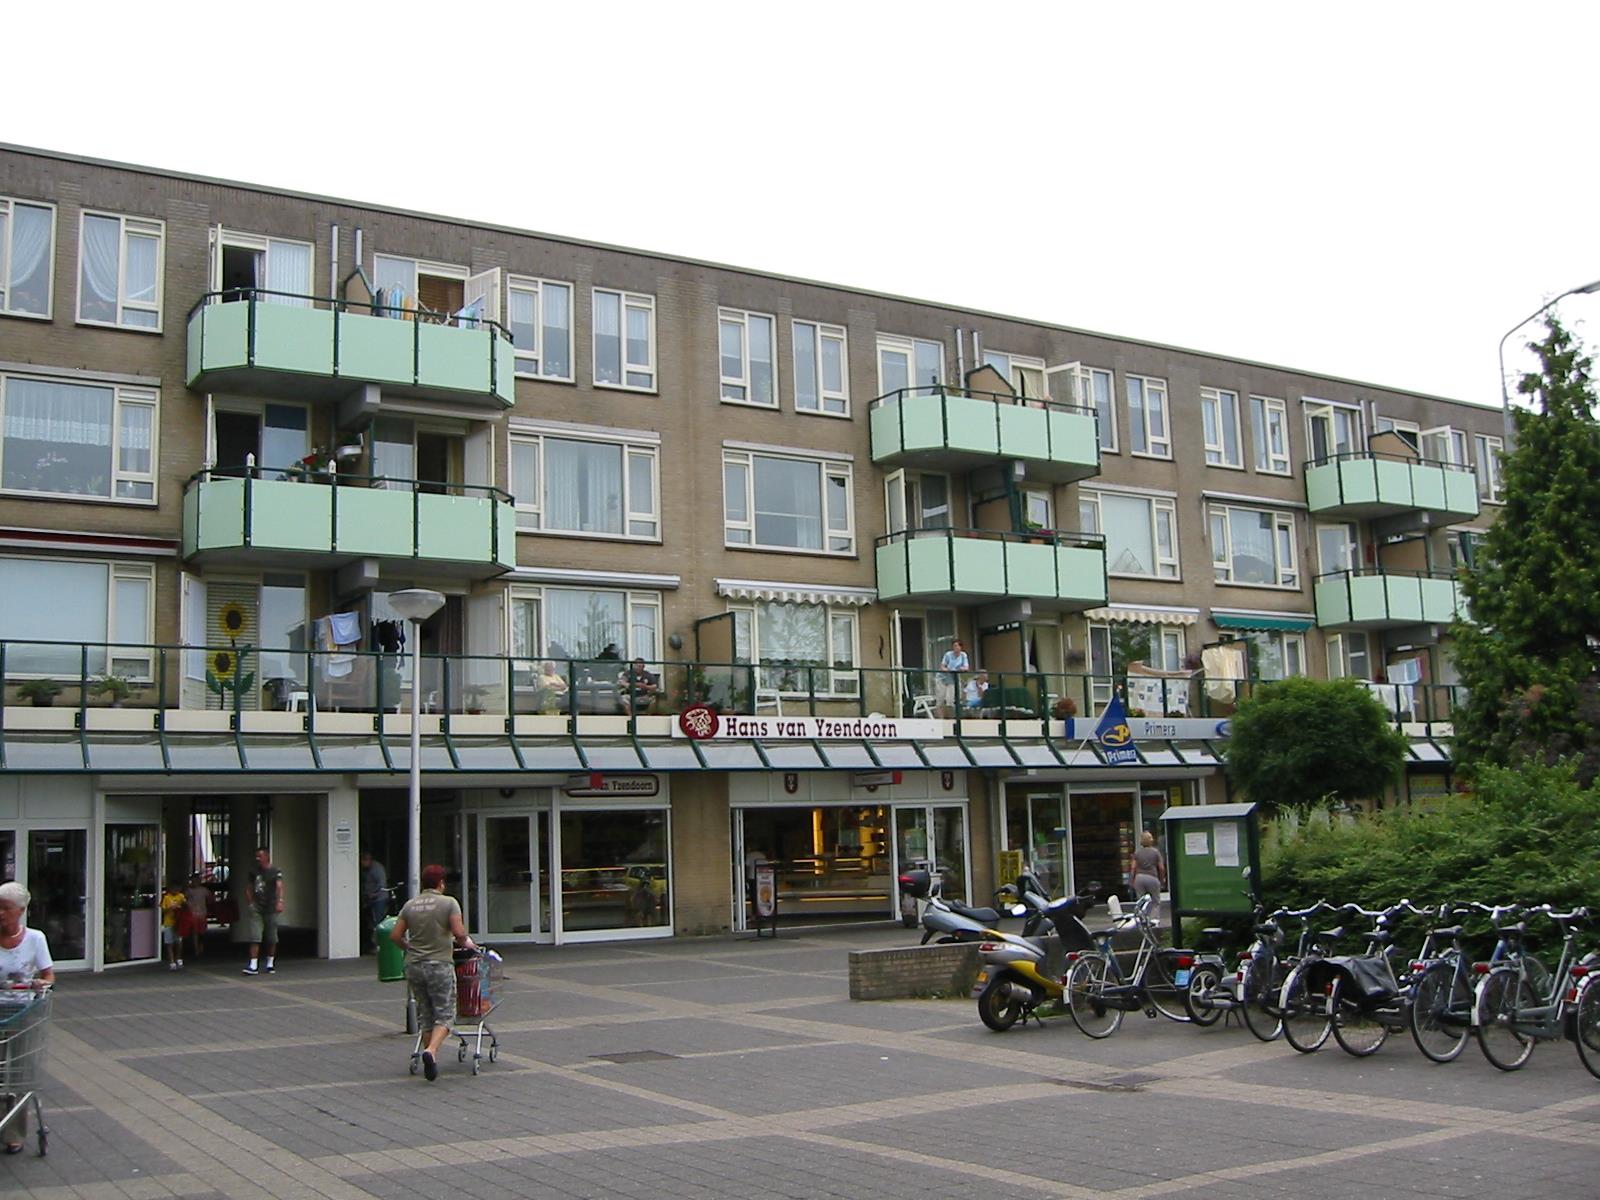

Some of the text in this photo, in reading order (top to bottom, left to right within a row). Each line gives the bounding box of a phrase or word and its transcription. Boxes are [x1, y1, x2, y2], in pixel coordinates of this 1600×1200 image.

[726, 717, 898, 738] Hans van Yzendoorn
[1145, 721, 1176, 736] Primera
